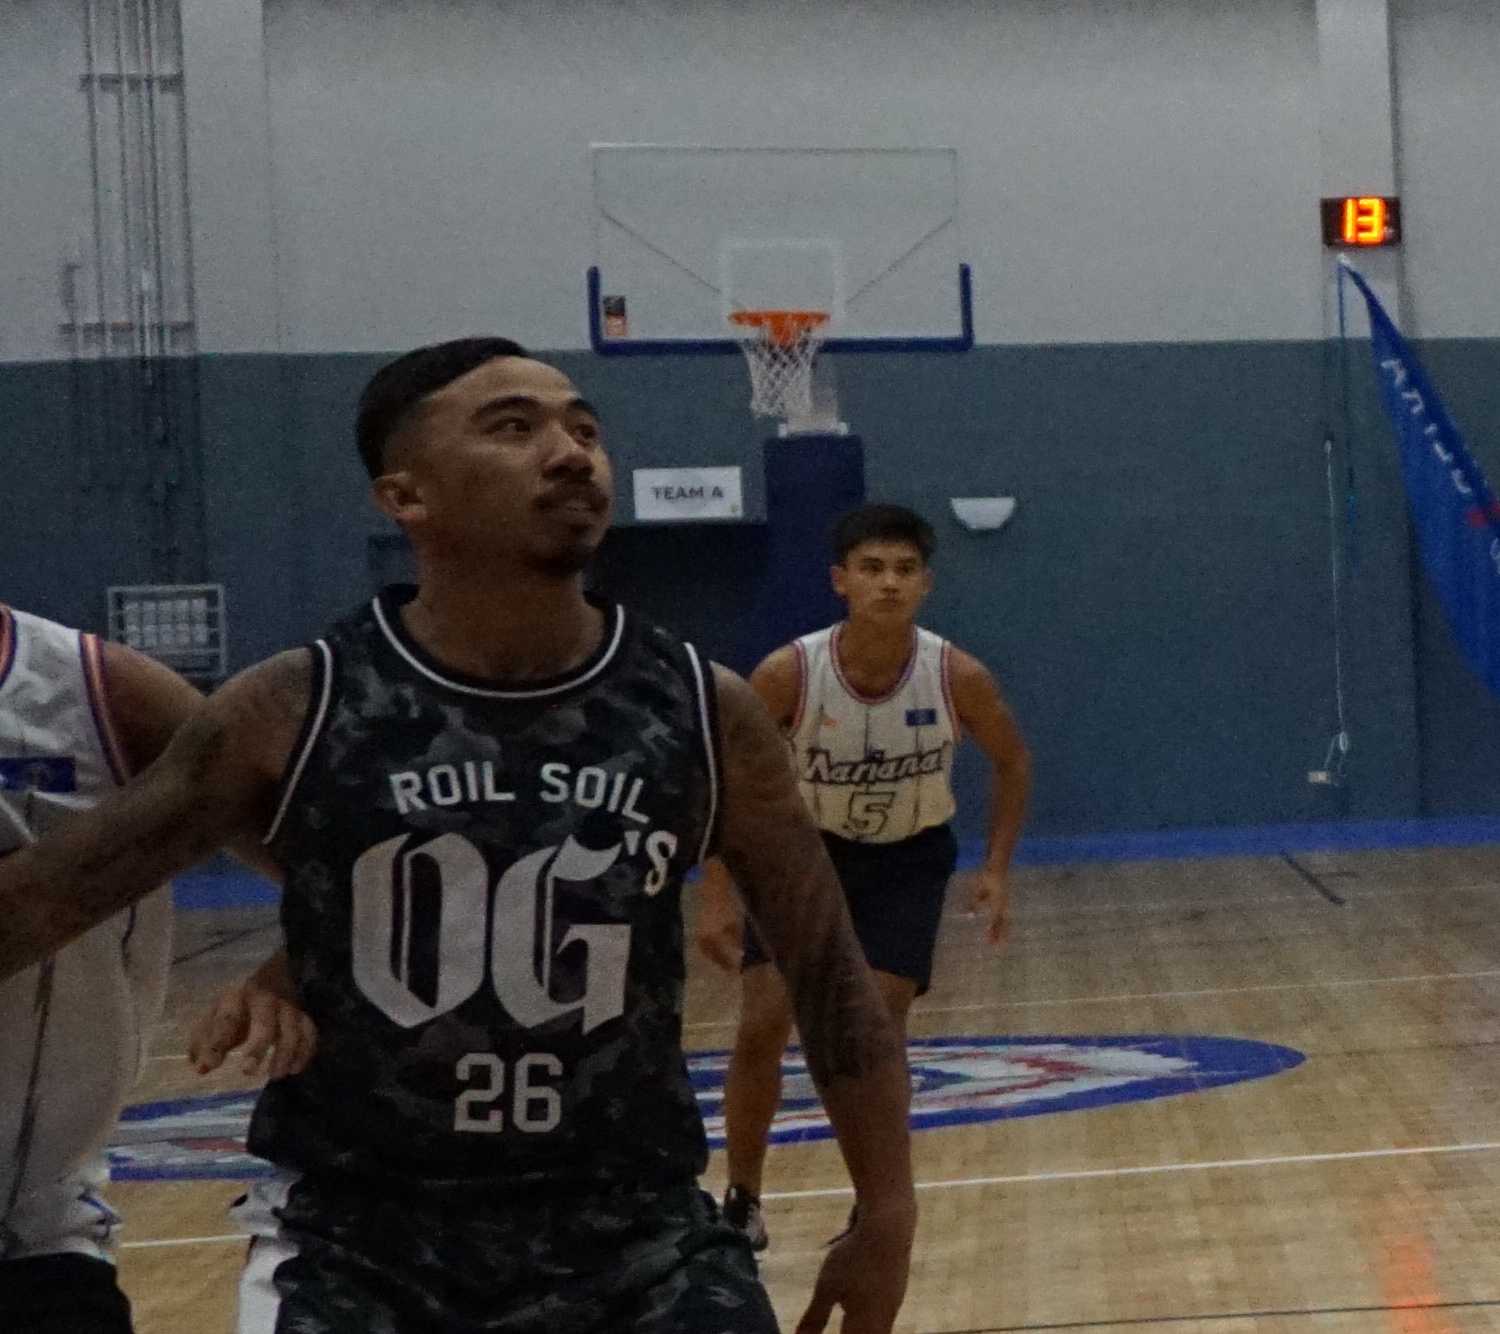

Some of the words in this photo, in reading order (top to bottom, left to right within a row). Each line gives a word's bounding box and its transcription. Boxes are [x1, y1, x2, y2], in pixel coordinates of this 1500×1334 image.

[1344, 196, 1384, 242] 13
[651, 485, 705, 501] TEAM
[712, 486, 725, 499] A
[389, 761, 516, 815] ROIL
[539, 762, 650, 824] SOIL
[843, 791, 897, 836] 5
[454, 1052, 562, 1133] 26
